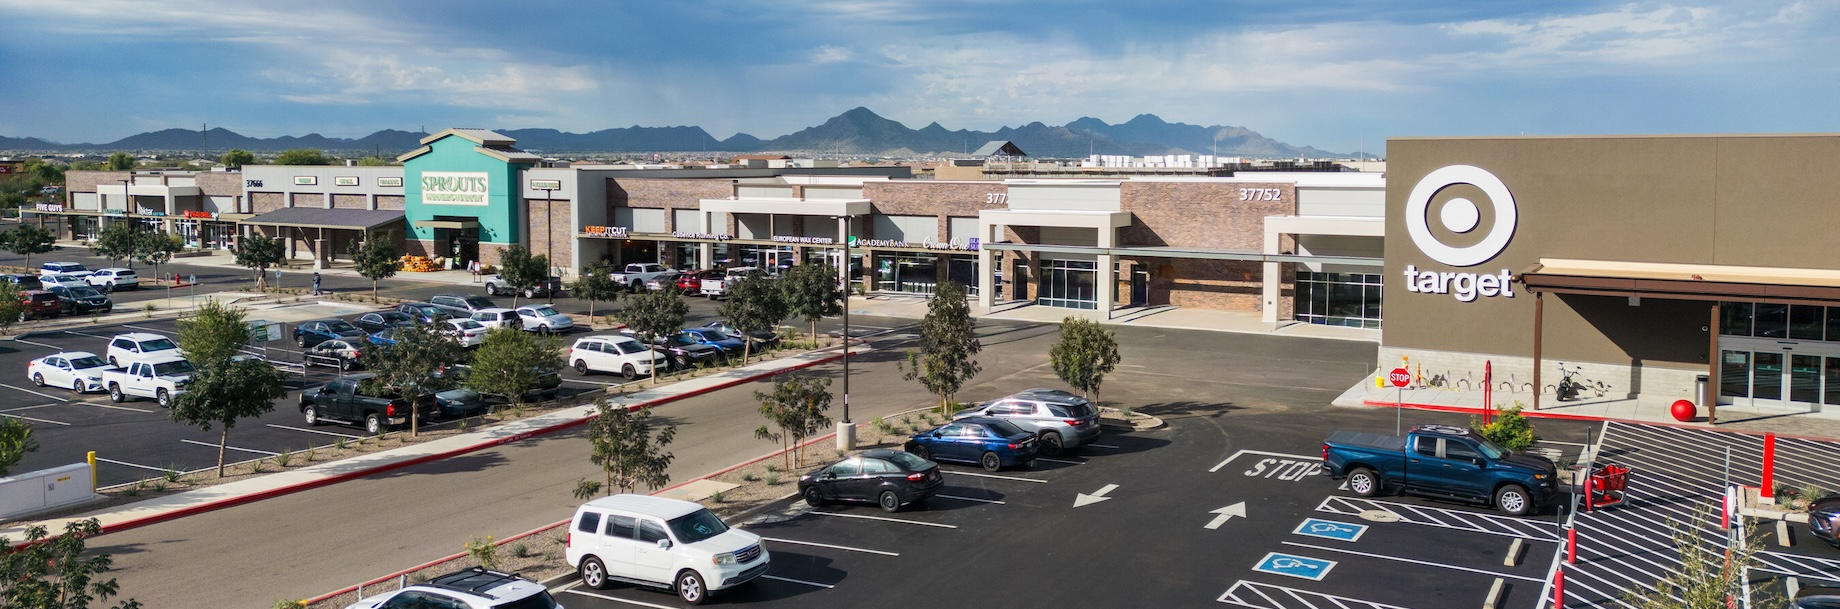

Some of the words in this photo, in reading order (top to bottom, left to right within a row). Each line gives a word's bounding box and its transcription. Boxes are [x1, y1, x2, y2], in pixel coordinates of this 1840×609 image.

[421, 176, 487, 192] SPROUTS
[986, 193, 1008, 204] 377
[1240, 188, 1281, 201] 37752
[36, 203, 48, 211] FIVE
[48, 204, 63, 212] GUYS
[773, 235, 800, 243] EUROPEAN
[922, 236, 948, 250] Crown
[949, 236, 970, 250] One
[1404, 265, 1513, 302] target
[1390, 373, 1410, 382] STOP
[1244, 458, 1322, 482] STOP
